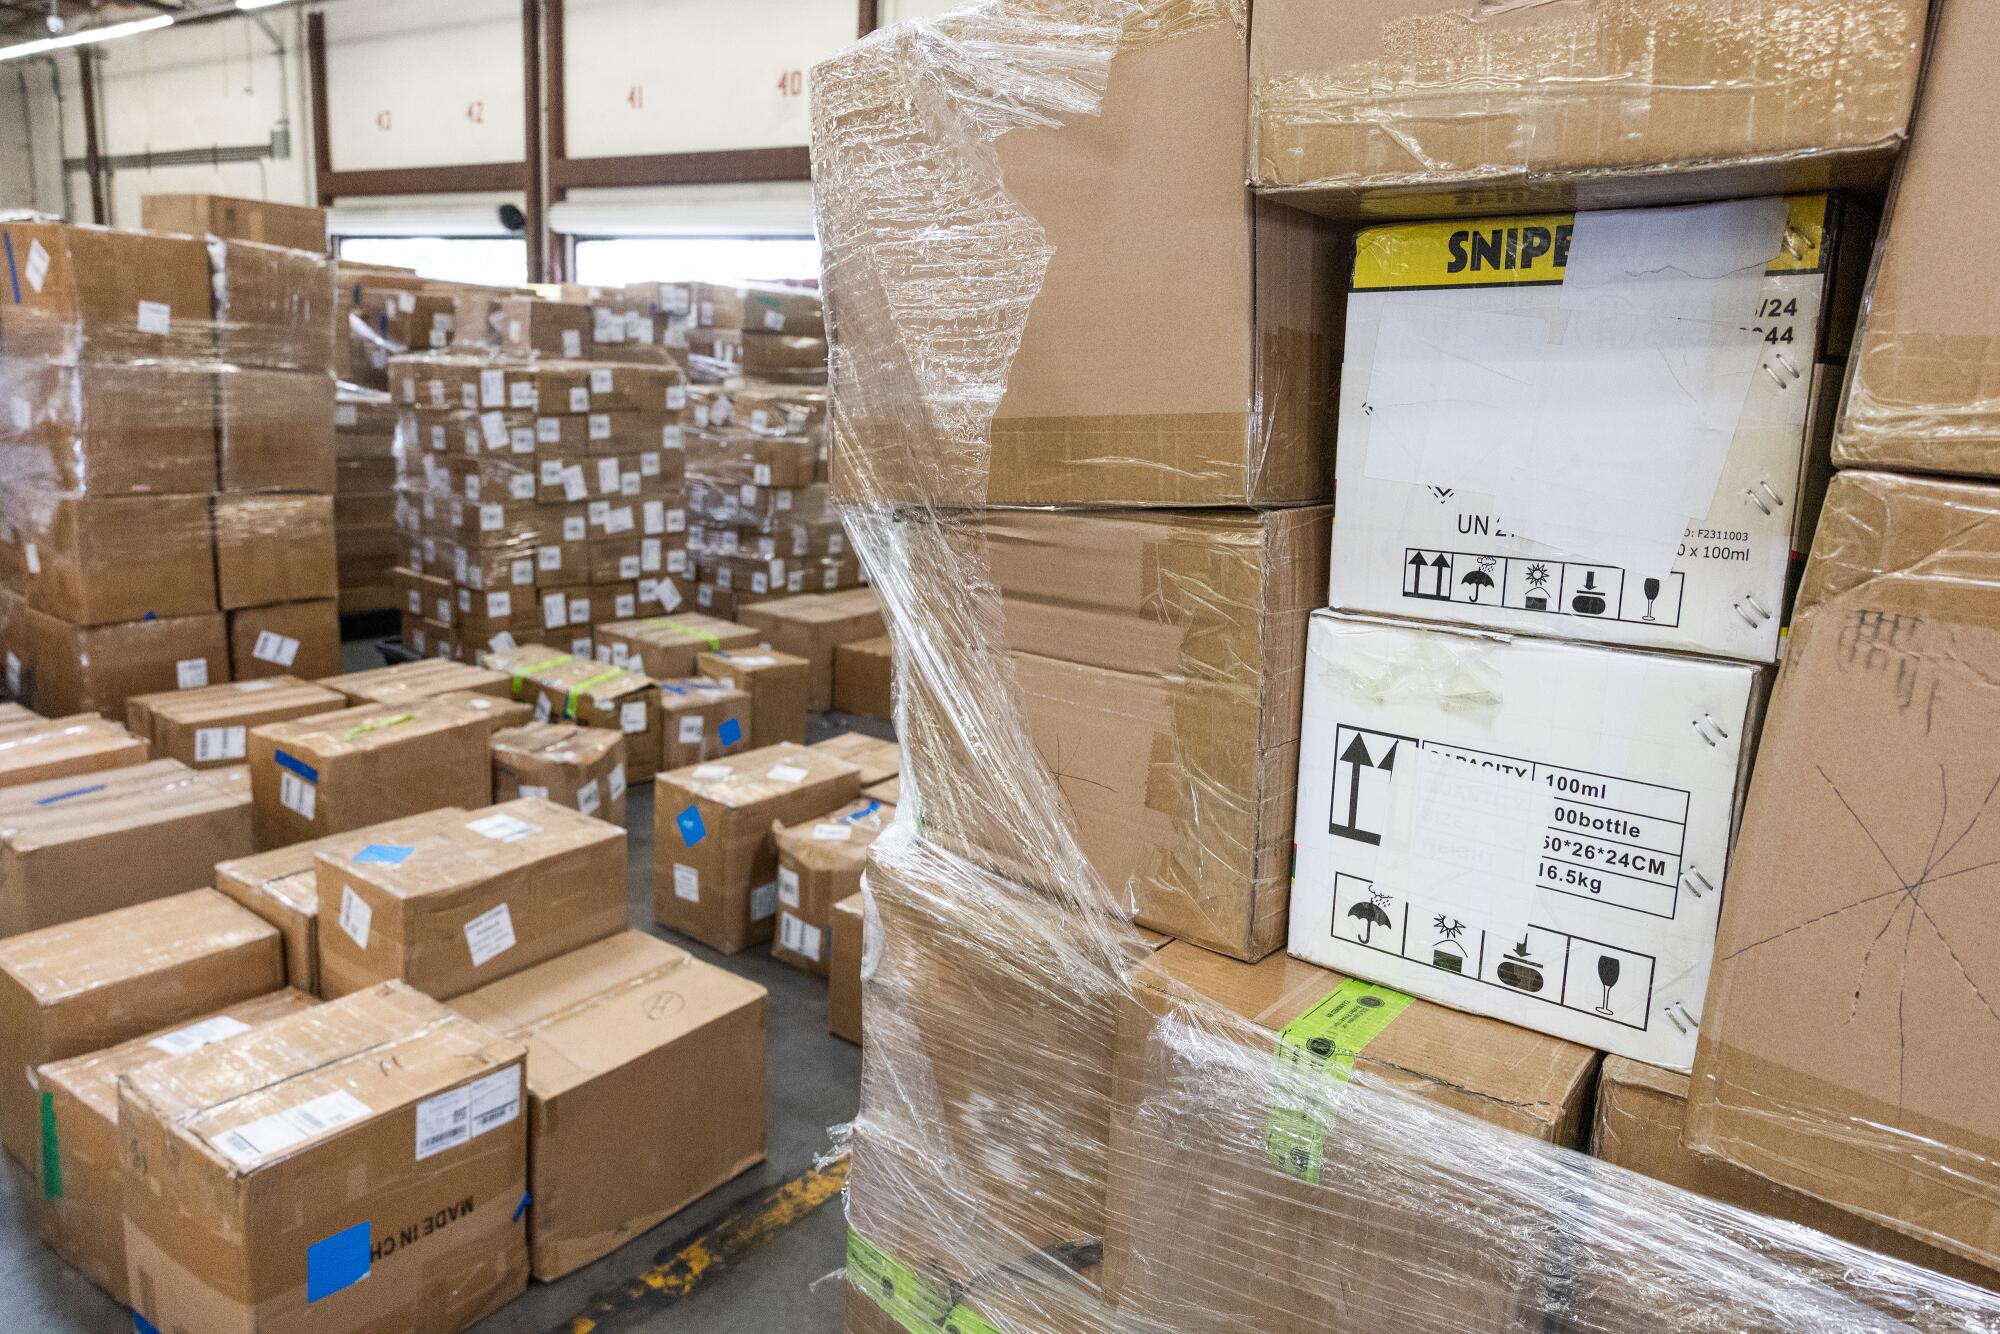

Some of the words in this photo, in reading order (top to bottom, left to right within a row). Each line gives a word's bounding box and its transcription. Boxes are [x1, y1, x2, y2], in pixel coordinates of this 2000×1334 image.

[777, 70, 803, 97] 40
[1754, 297, 1798, 318] /24
[1457, 513, 1489, 536] UN
[1697, 529, 1749, 542] F2311003
[1703, 545, 1750, 562] 100ml
[1546, 773, 1606, 799] 100ml
[424, 1195, 474, 1237] MADE
[400, 1224, 419, 1249] IN
